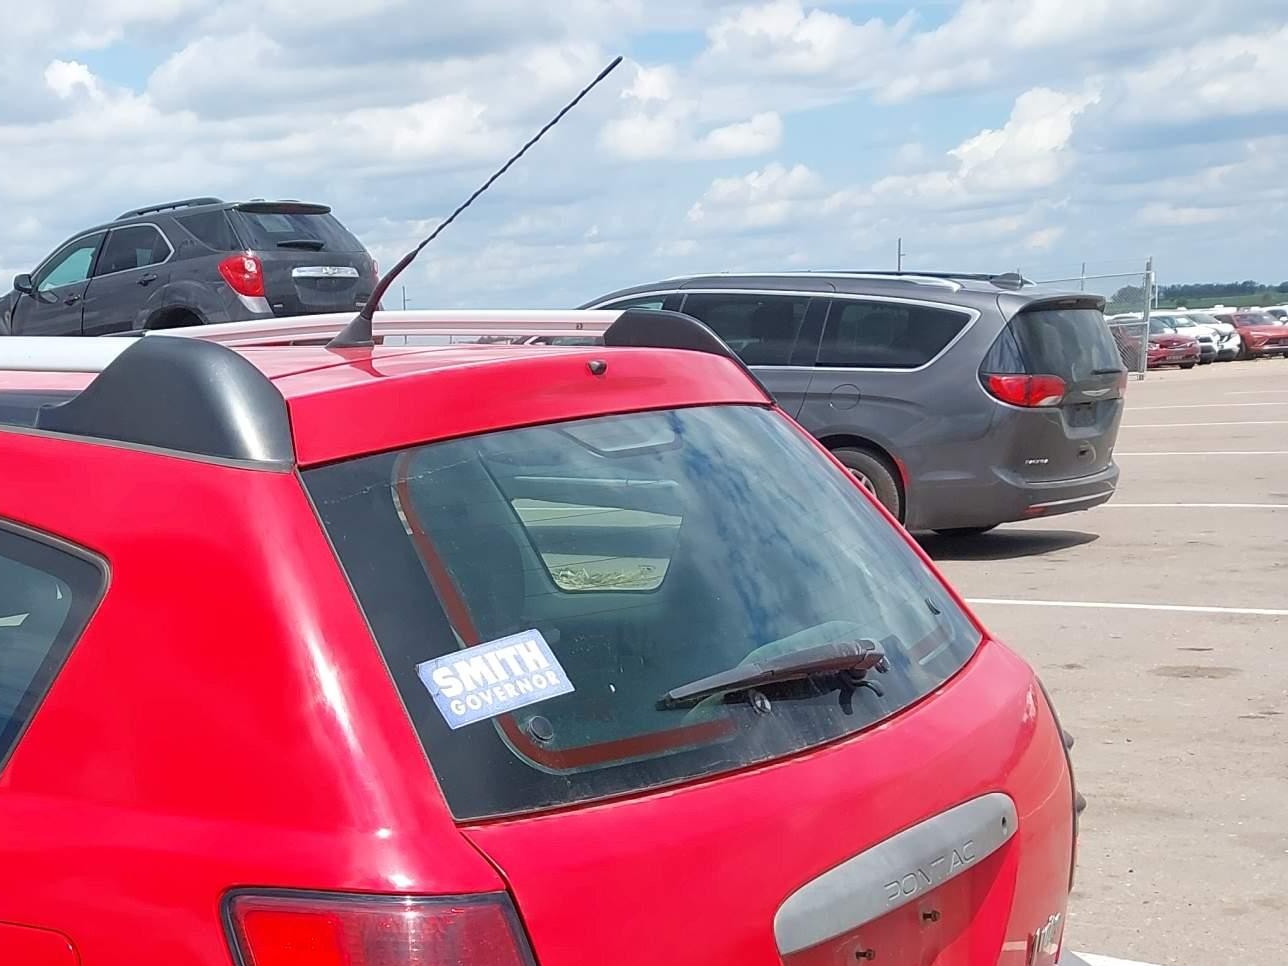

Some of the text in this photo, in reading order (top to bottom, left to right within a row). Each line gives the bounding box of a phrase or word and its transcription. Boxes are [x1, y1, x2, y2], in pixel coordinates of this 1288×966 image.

[432, 640, 550, 697] SMITH
[450, 670, 561, 715] GOVERNOR
[883, 840, 975, 903] PONTAC
